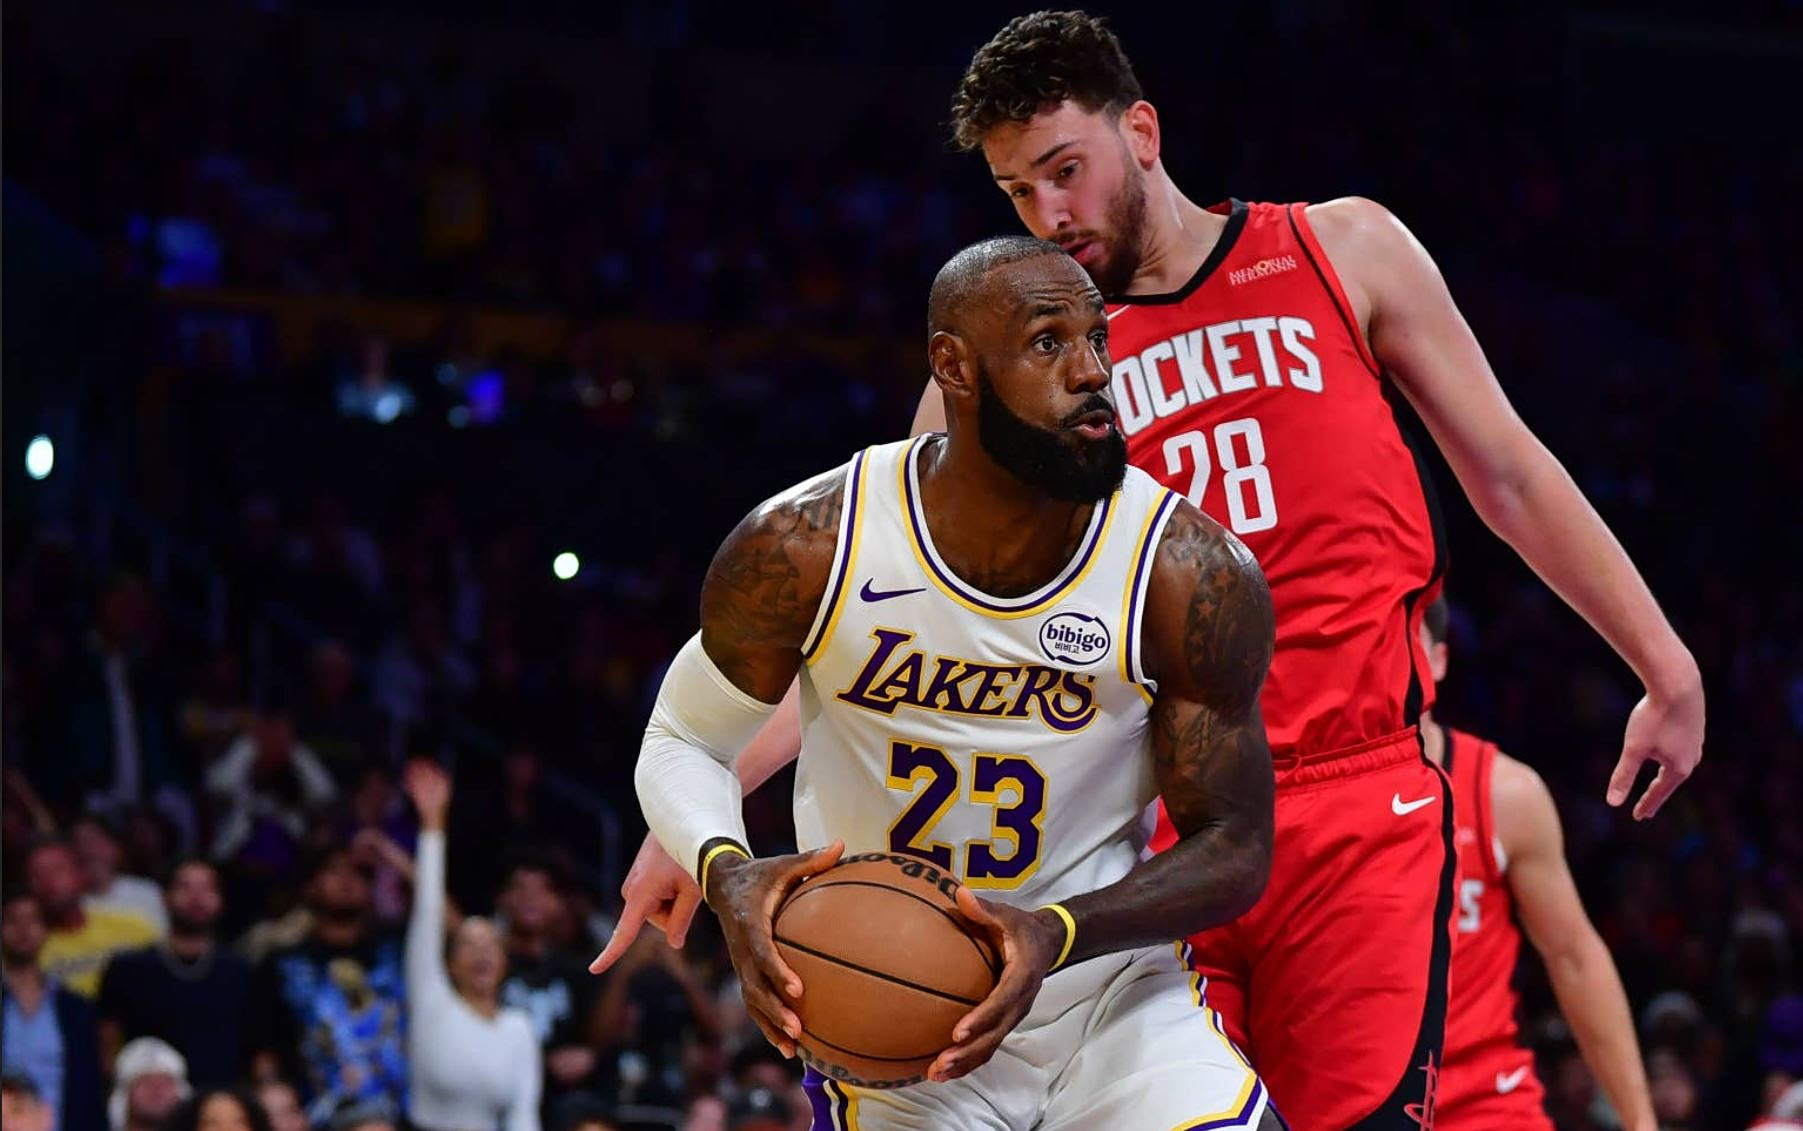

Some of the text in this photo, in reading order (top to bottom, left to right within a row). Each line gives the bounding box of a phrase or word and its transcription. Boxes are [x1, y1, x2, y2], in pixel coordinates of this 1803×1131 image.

[1111, 316, 1324, 437] OCKETS
[1162, 417, 1278, 534] 28
[834, 625, 1101, 733] LAKERS
[1046, 623, 1106, 652] bibigo
[1055, 642, 1080, 654] 비비고
[886, 738, 1048, 890] 23
